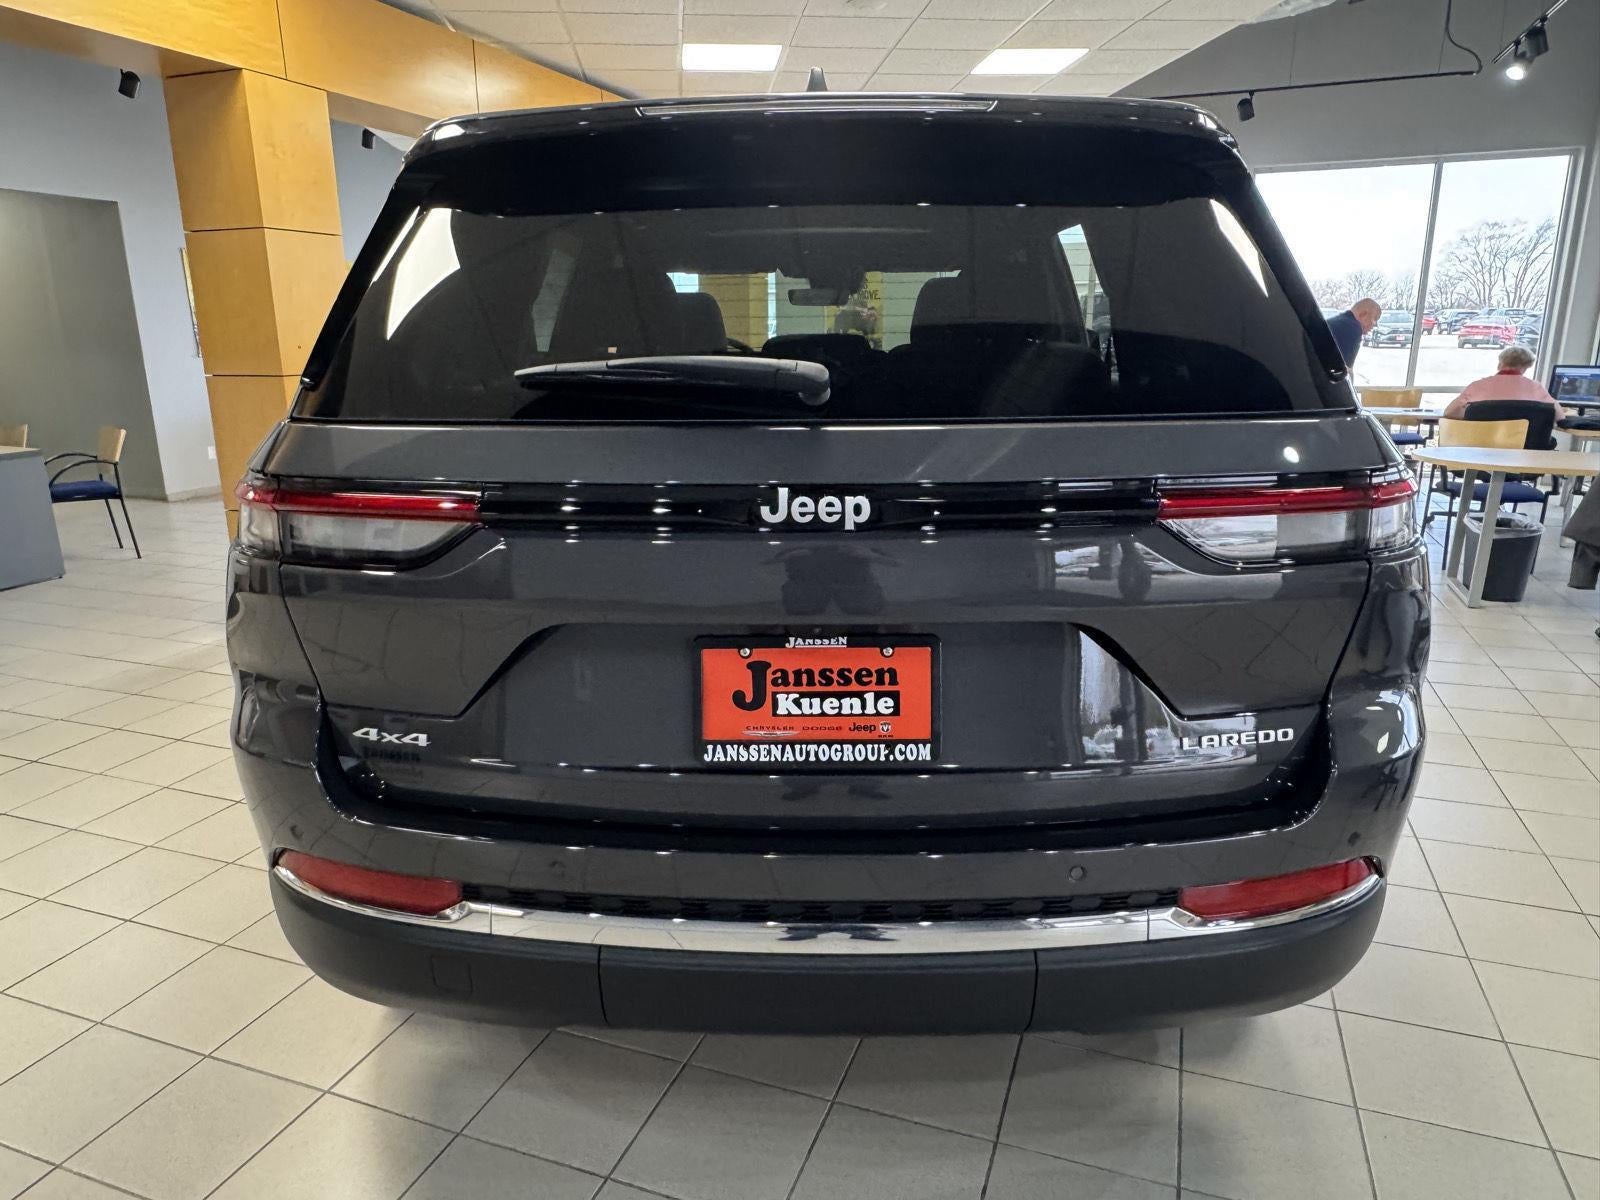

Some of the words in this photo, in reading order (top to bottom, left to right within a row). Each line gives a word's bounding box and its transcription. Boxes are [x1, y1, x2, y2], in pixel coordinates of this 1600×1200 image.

[760, 486, 871, 530] Jeep
[785, 636, 848, 648] JANSSEN
[732, 660, 900, 711] Janssen
[776, 691, 895, 715] Kuenle
[352, 727, 432, 747] 4x4
[849, 722, 877, 733] Jeep
[1182, 728, 1294, 750] LAREDO
[703, 742, 932, 762] JANSSENAUTOGROUP.COM
